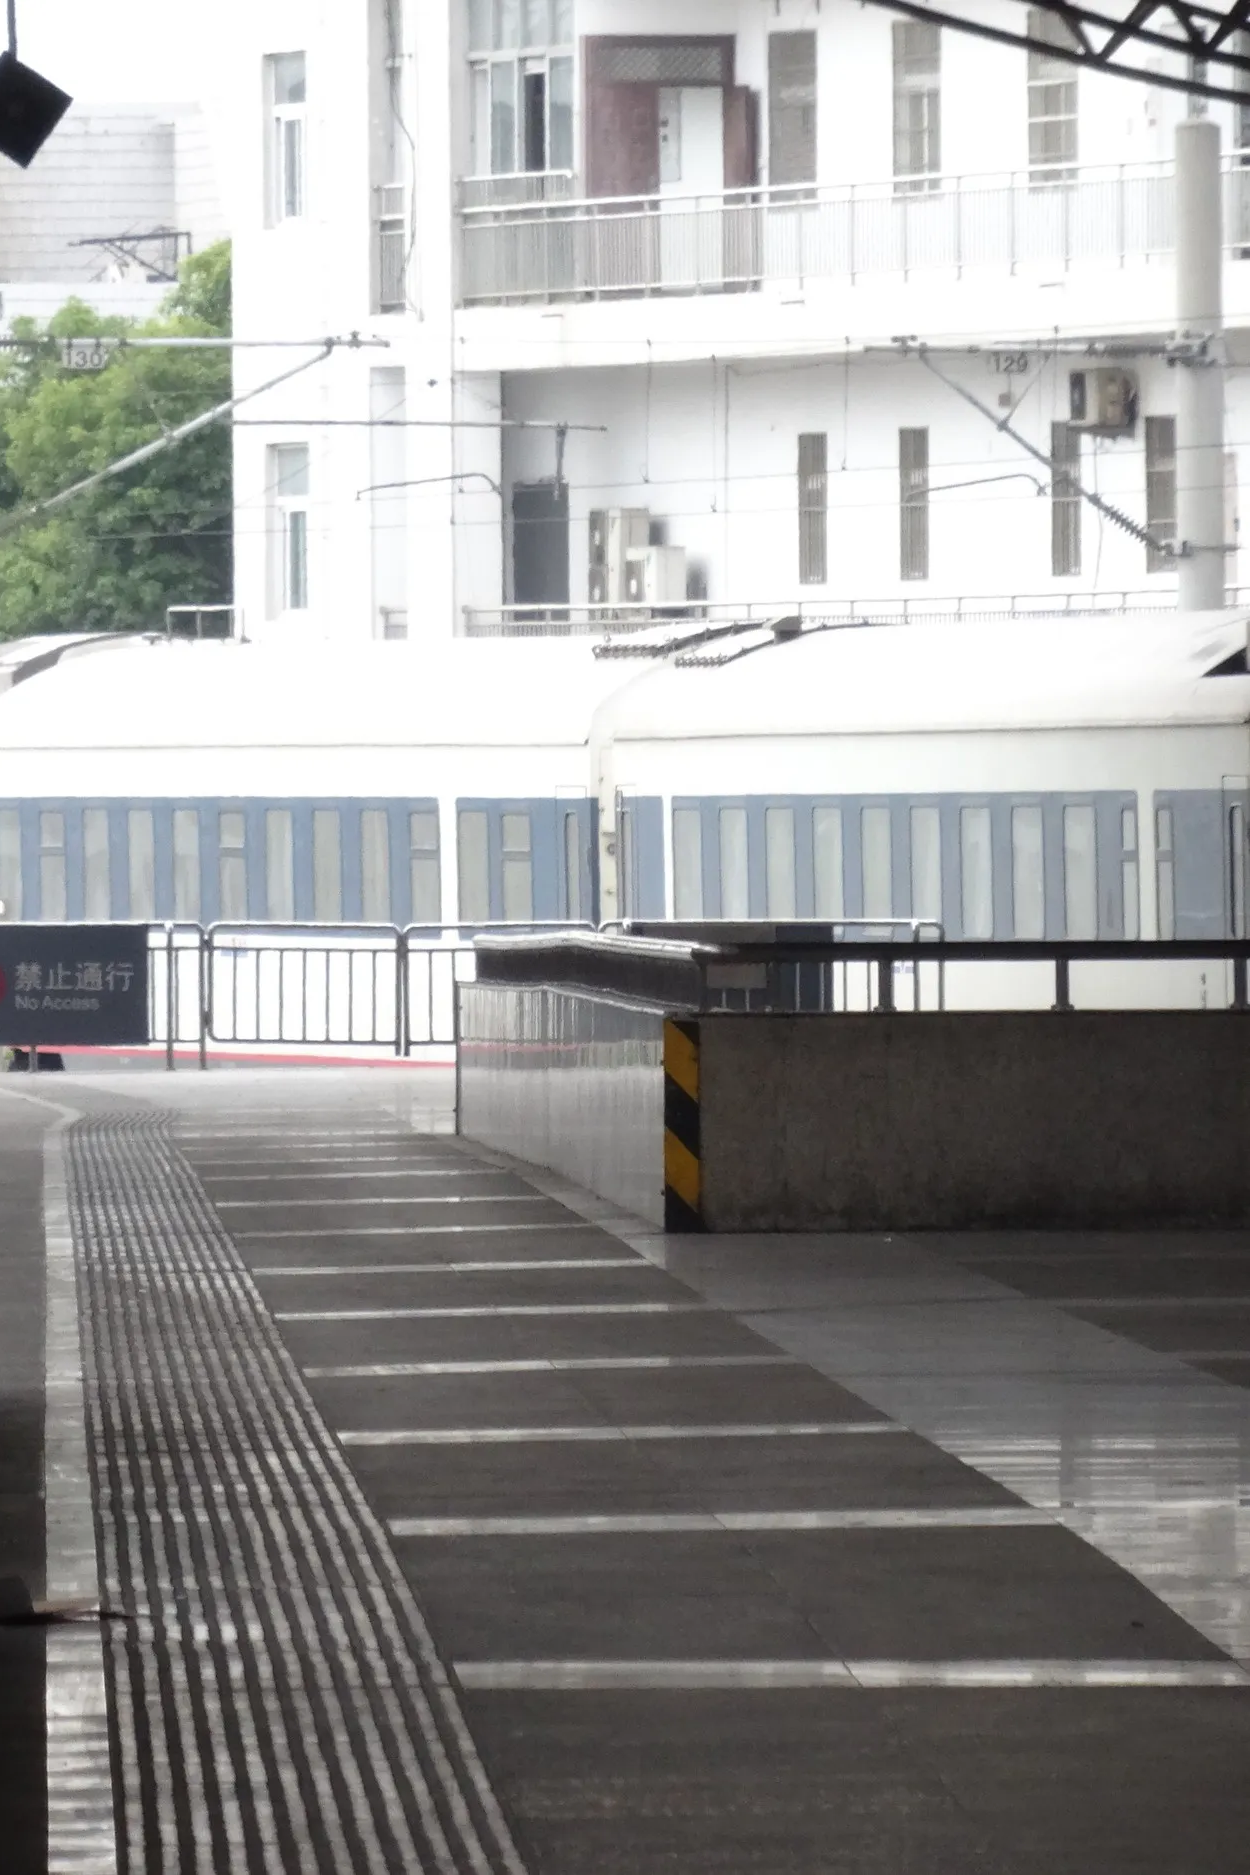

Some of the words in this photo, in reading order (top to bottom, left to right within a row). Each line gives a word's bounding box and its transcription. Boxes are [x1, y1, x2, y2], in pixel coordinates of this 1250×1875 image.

[66, 350, 103, 368] 130
[993, 352, 1029, 373] 129
[15, 961, 134, 992] 禁止通行
[15, 996, 39, 1010] No
[42, 995, 100, 1010] Access
